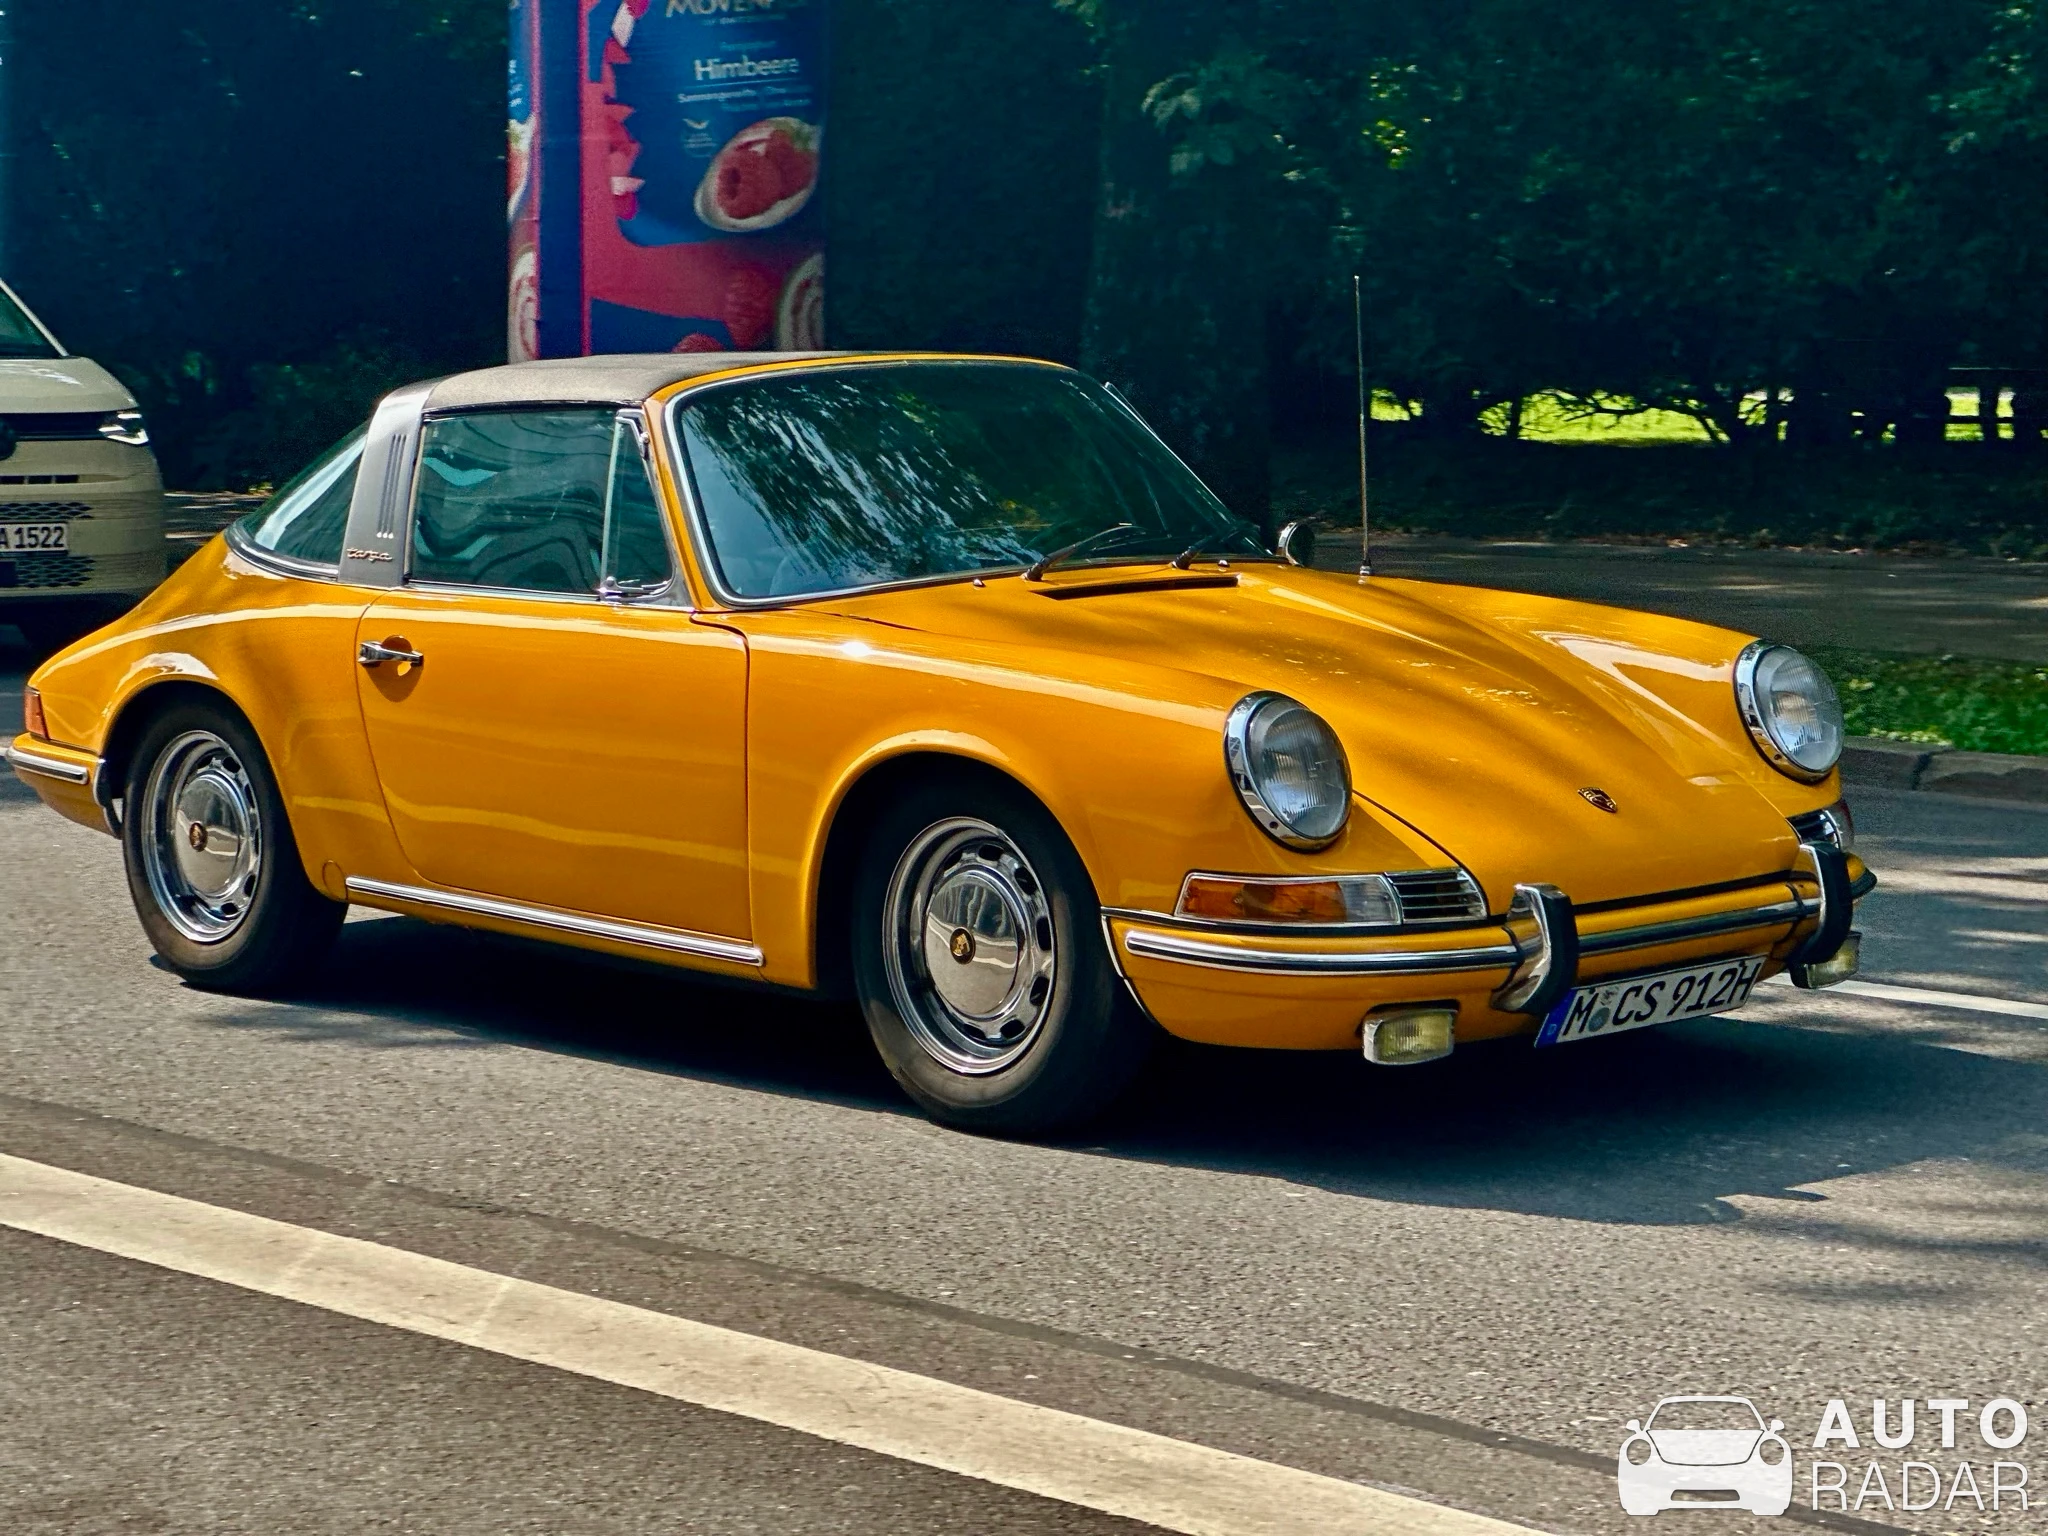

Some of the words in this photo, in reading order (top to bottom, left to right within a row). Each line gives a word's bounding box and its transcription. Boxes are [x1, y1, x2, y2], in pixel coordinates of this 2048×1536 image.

[14, 526, 65, 549] 1522
[1612, 980, 1667, 1026] CS
[1667, 962, 1762, 1017] 912H
